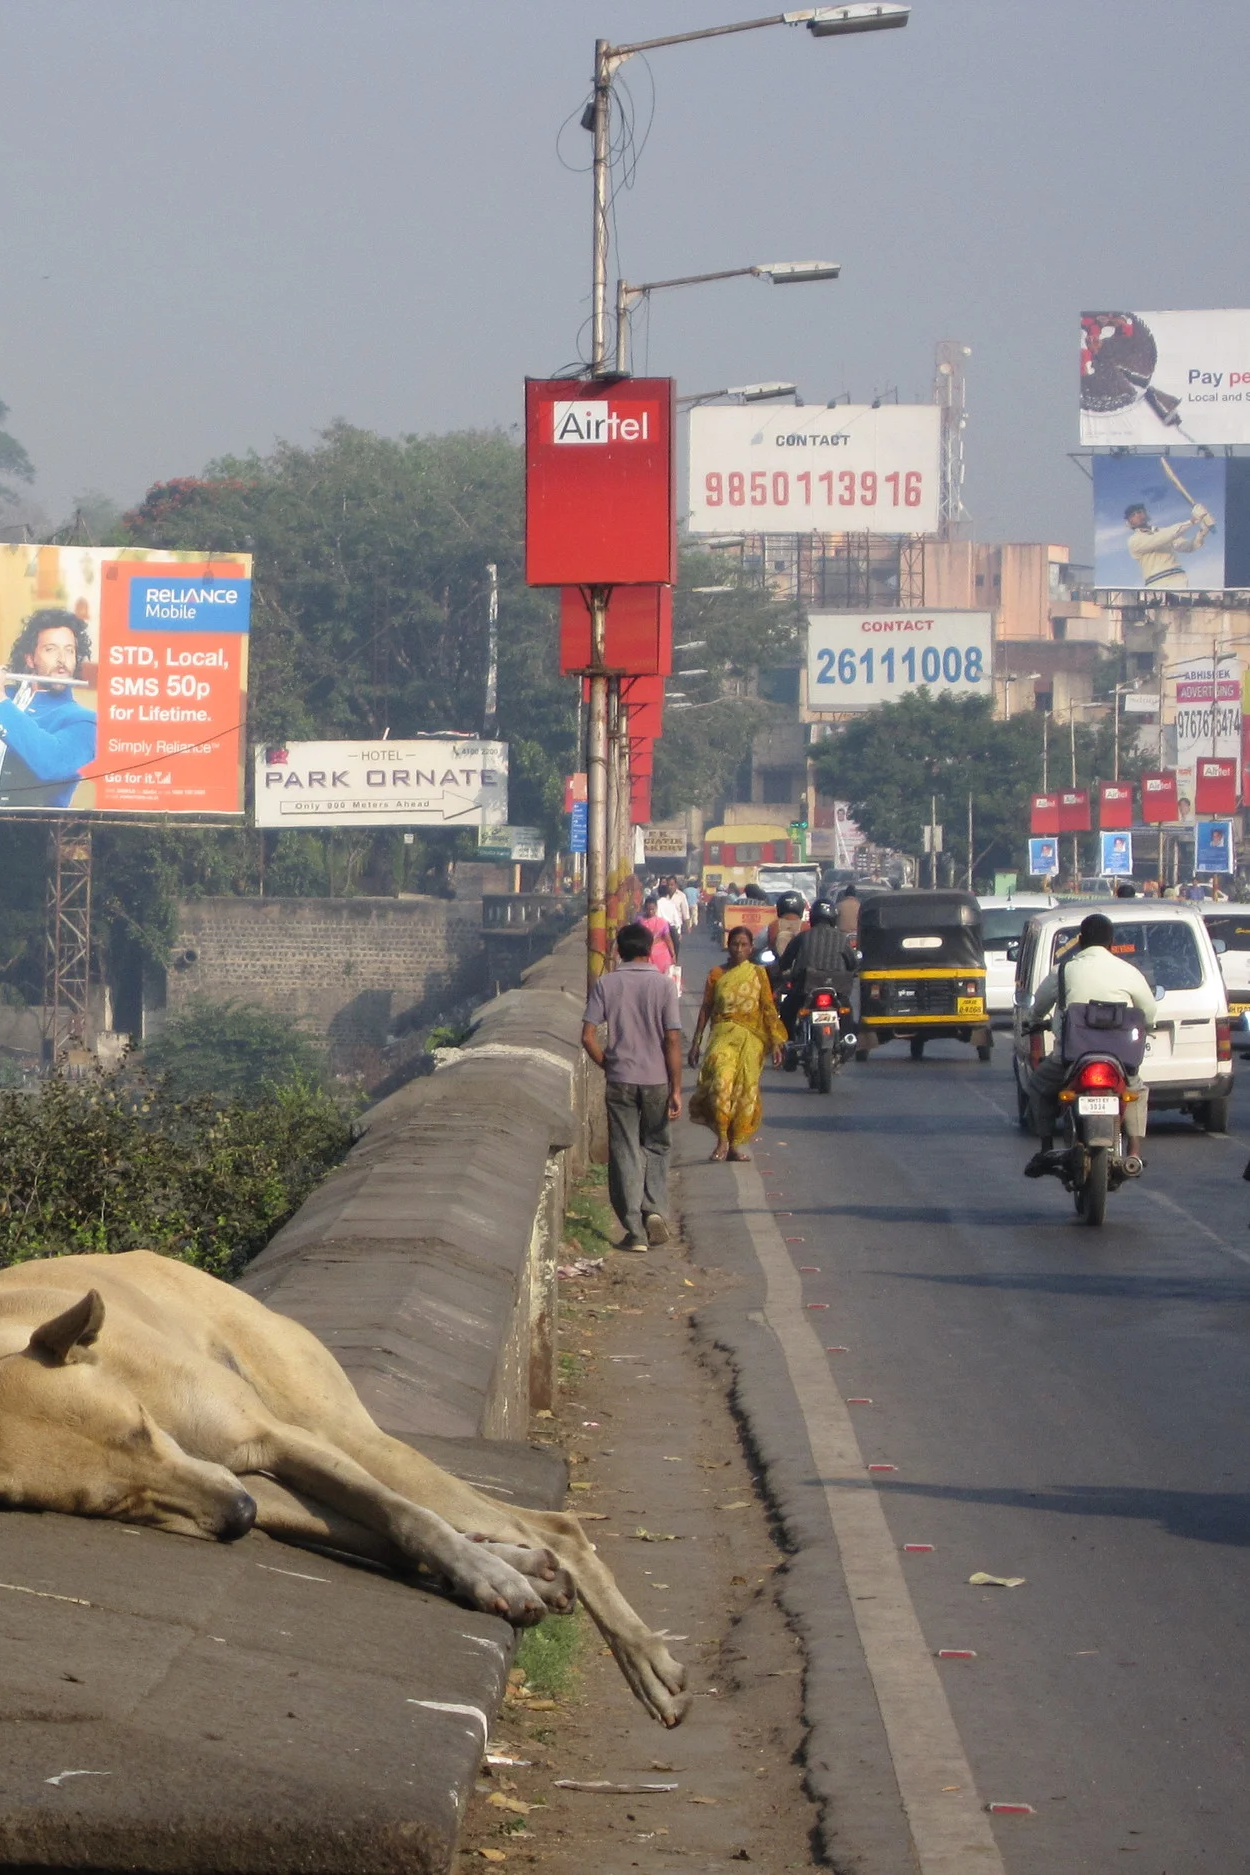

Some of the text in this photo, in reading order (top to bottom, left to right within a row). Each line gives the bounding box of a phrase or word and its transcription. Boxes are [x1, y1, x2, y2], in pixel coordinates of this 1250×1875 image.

[1188, 369, 1224, 388] Pay
[1188, 392, 1219, 402] Local
[1221, 391, 1243, 402] and
[558, 411, 649, 441] Airtel
[775, 434, 851, 447] CONTACT
[705, 470, 923, 507] 9850113916
[145, 603, 197, 619] Mobile
[861, 619, 935, 633] CONTACT
[109, 645, 230, 670] STD, Local,
[816, 646, 984, 684] 26111008
[109, 674, 211, 700] SMS 50p
[109, 704, 212, 722] for Lifetime.
[108, 738, 153, 757] Simply
[361, 750, 403, 761] HOTEL
[105, 772, 122, 784] Go
[125, 772, 142, 784] for
[265, 769, 499, 789] PARK ORNATE
[294, 802, 320, 810] Only
[396, 800, 430, 808] Ahead
